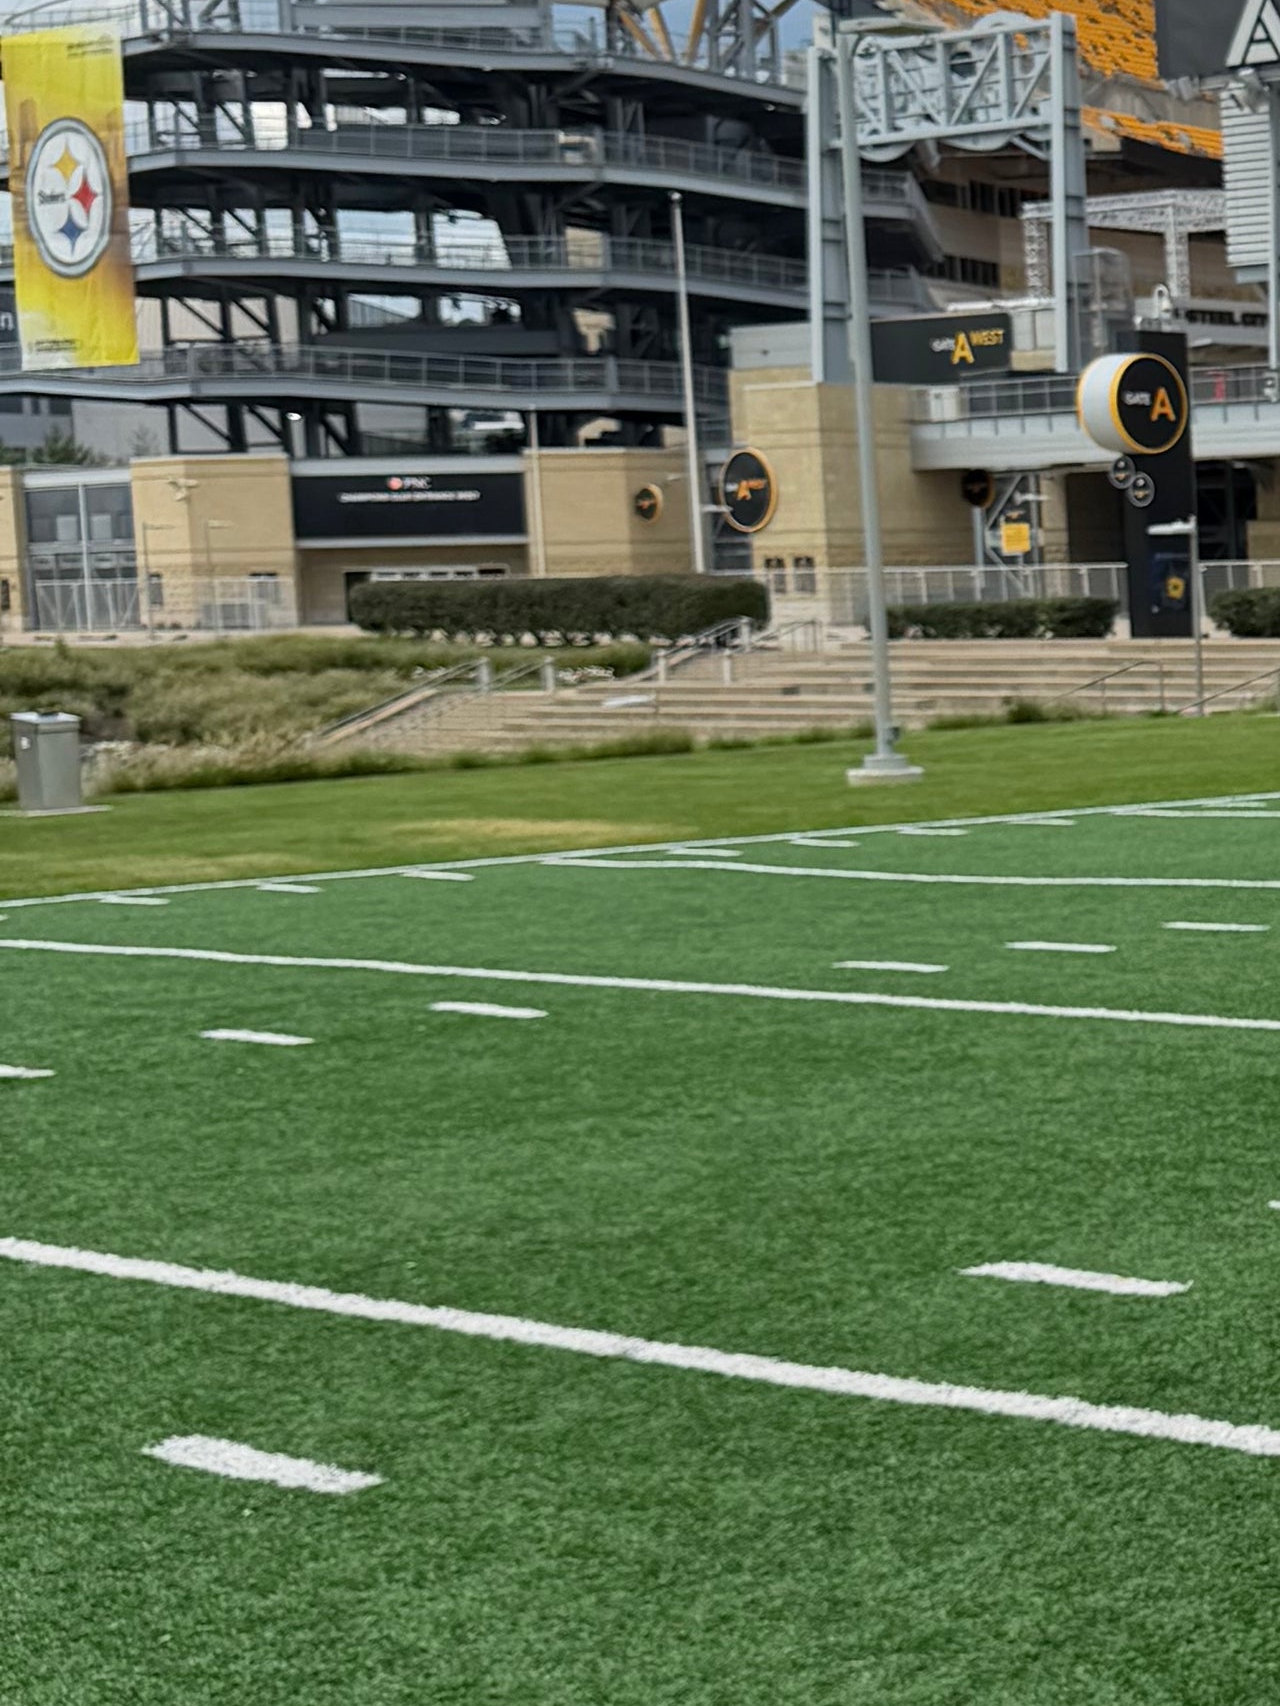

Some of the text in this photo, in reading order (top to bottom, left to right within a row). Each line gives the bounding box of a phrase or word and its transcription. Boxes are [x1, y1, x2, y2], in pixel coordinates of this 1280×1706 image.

[951, 332, 975, 364] A
[969, 329, 1004, 346] WEST
[1151, 387, 1176, 422] A
